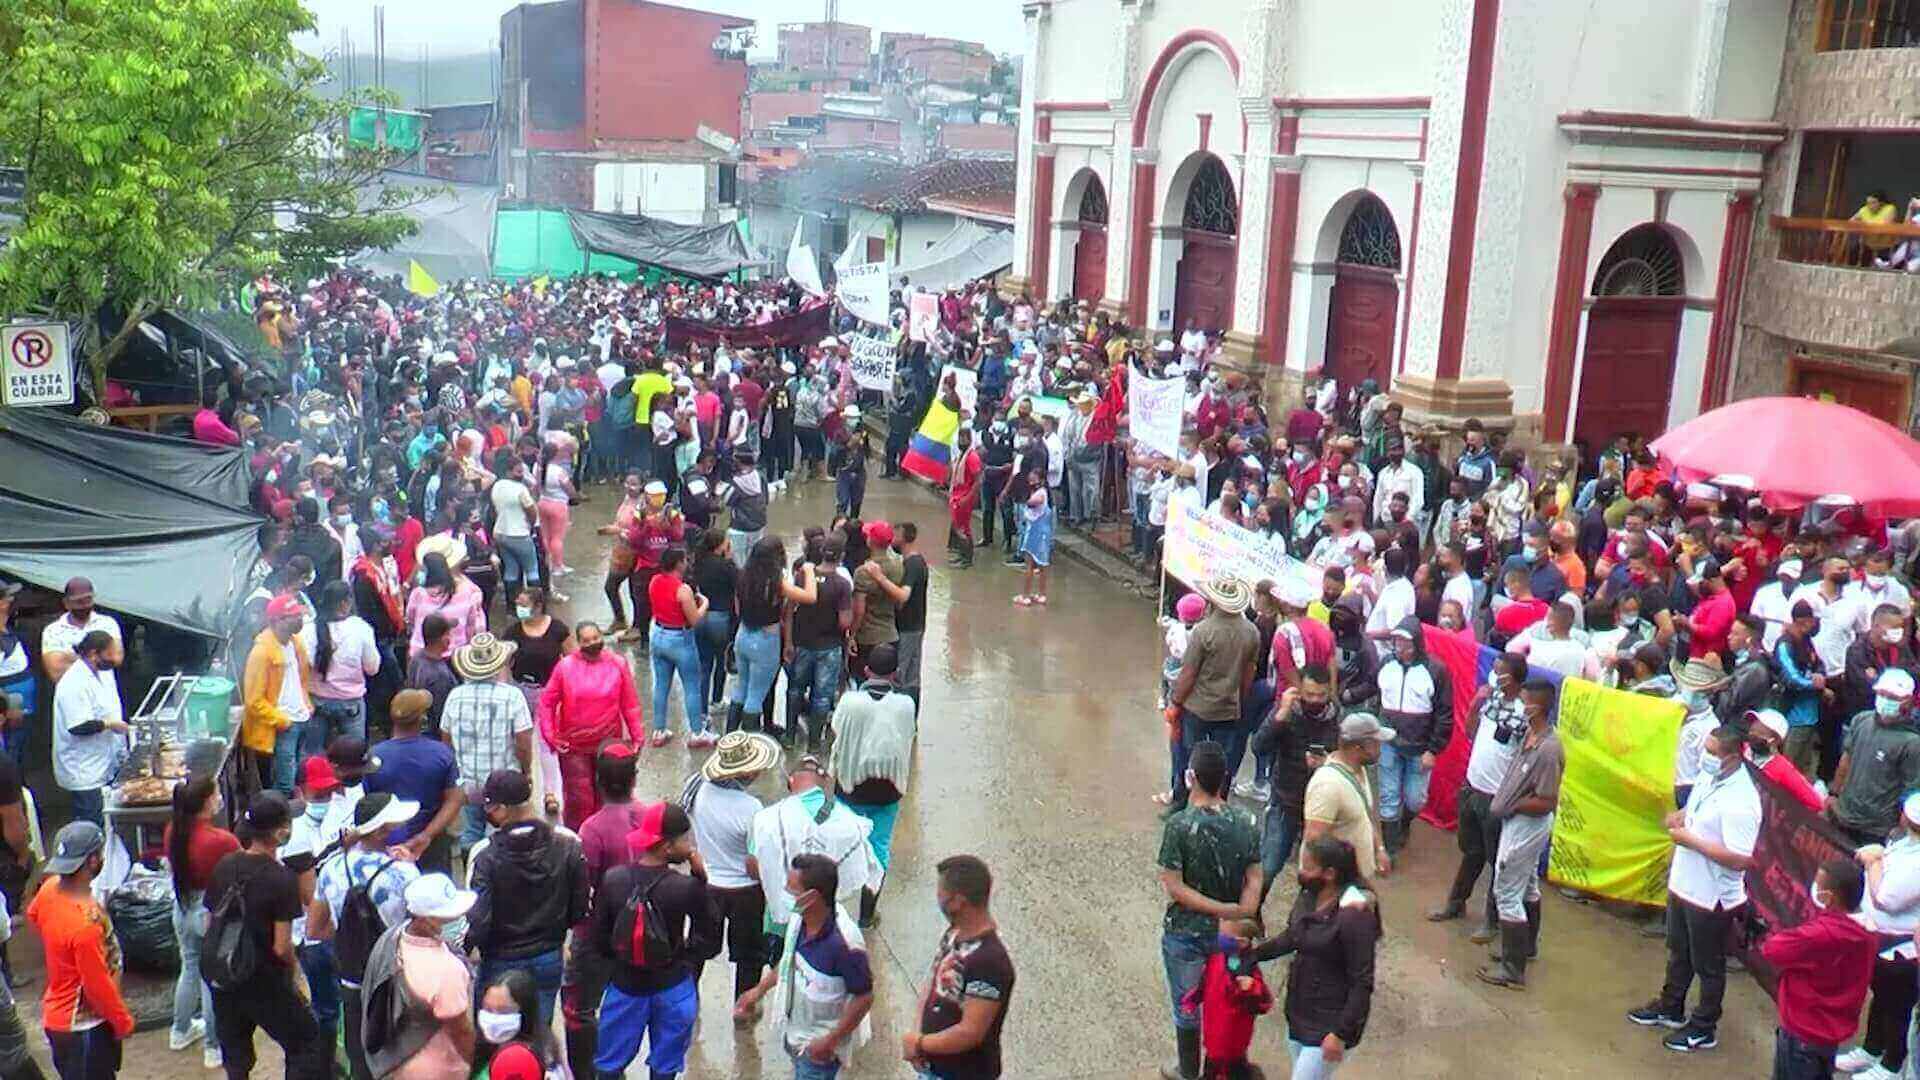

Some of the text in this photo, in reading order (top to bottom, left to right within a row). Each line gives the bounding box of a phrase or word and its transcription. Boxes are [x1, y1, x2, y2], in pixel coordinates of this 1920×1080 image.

[11, 374, 62, 386] EN ESTA
[12, 385, 63, 398] CUADRA
